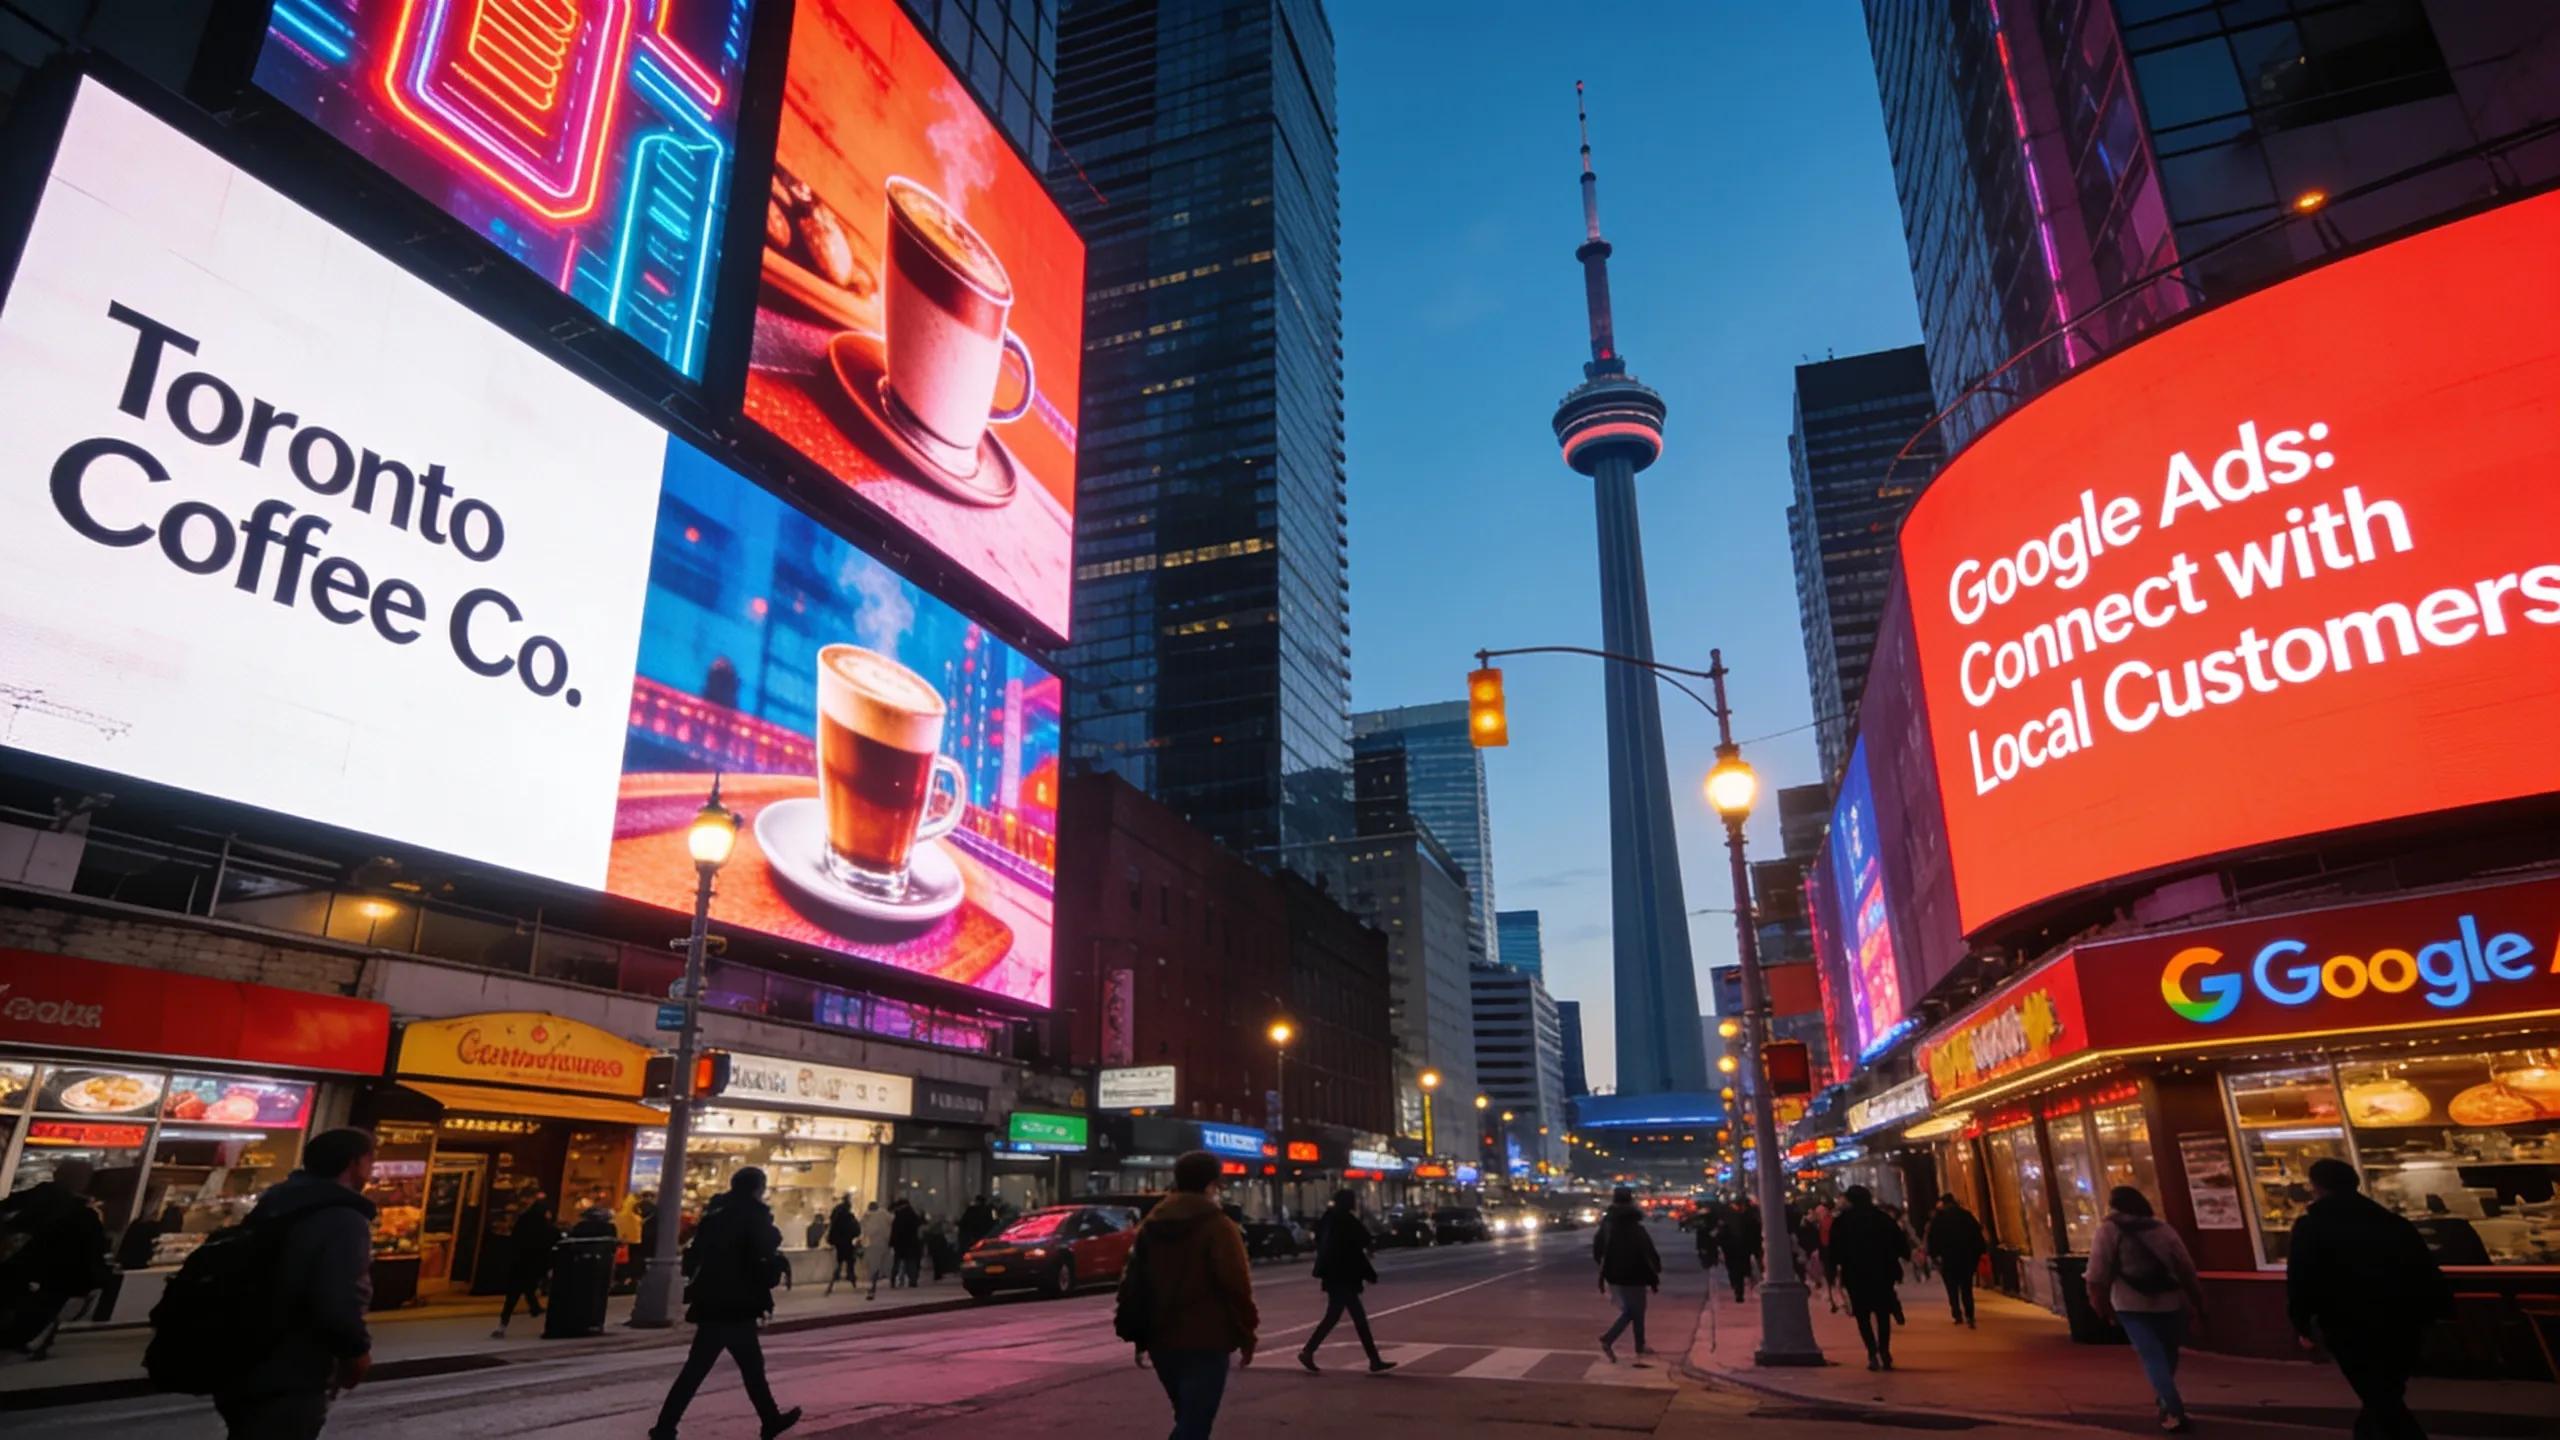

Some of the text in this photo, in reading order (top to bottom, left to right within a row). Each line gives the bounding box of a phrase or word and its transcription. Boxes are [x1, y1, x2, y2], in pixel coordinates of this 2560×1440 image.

[107, 300, 504, 562] Toronto
[1949, 420, 2335, 626] Google Ads:
[50, 437, 582, 707] Coffee Co.
[1960, 486, 2414, 707] Connect with
[1969, 564, 2560, 796] Local Customers
[2253, 914, 2536, 1008] Google
